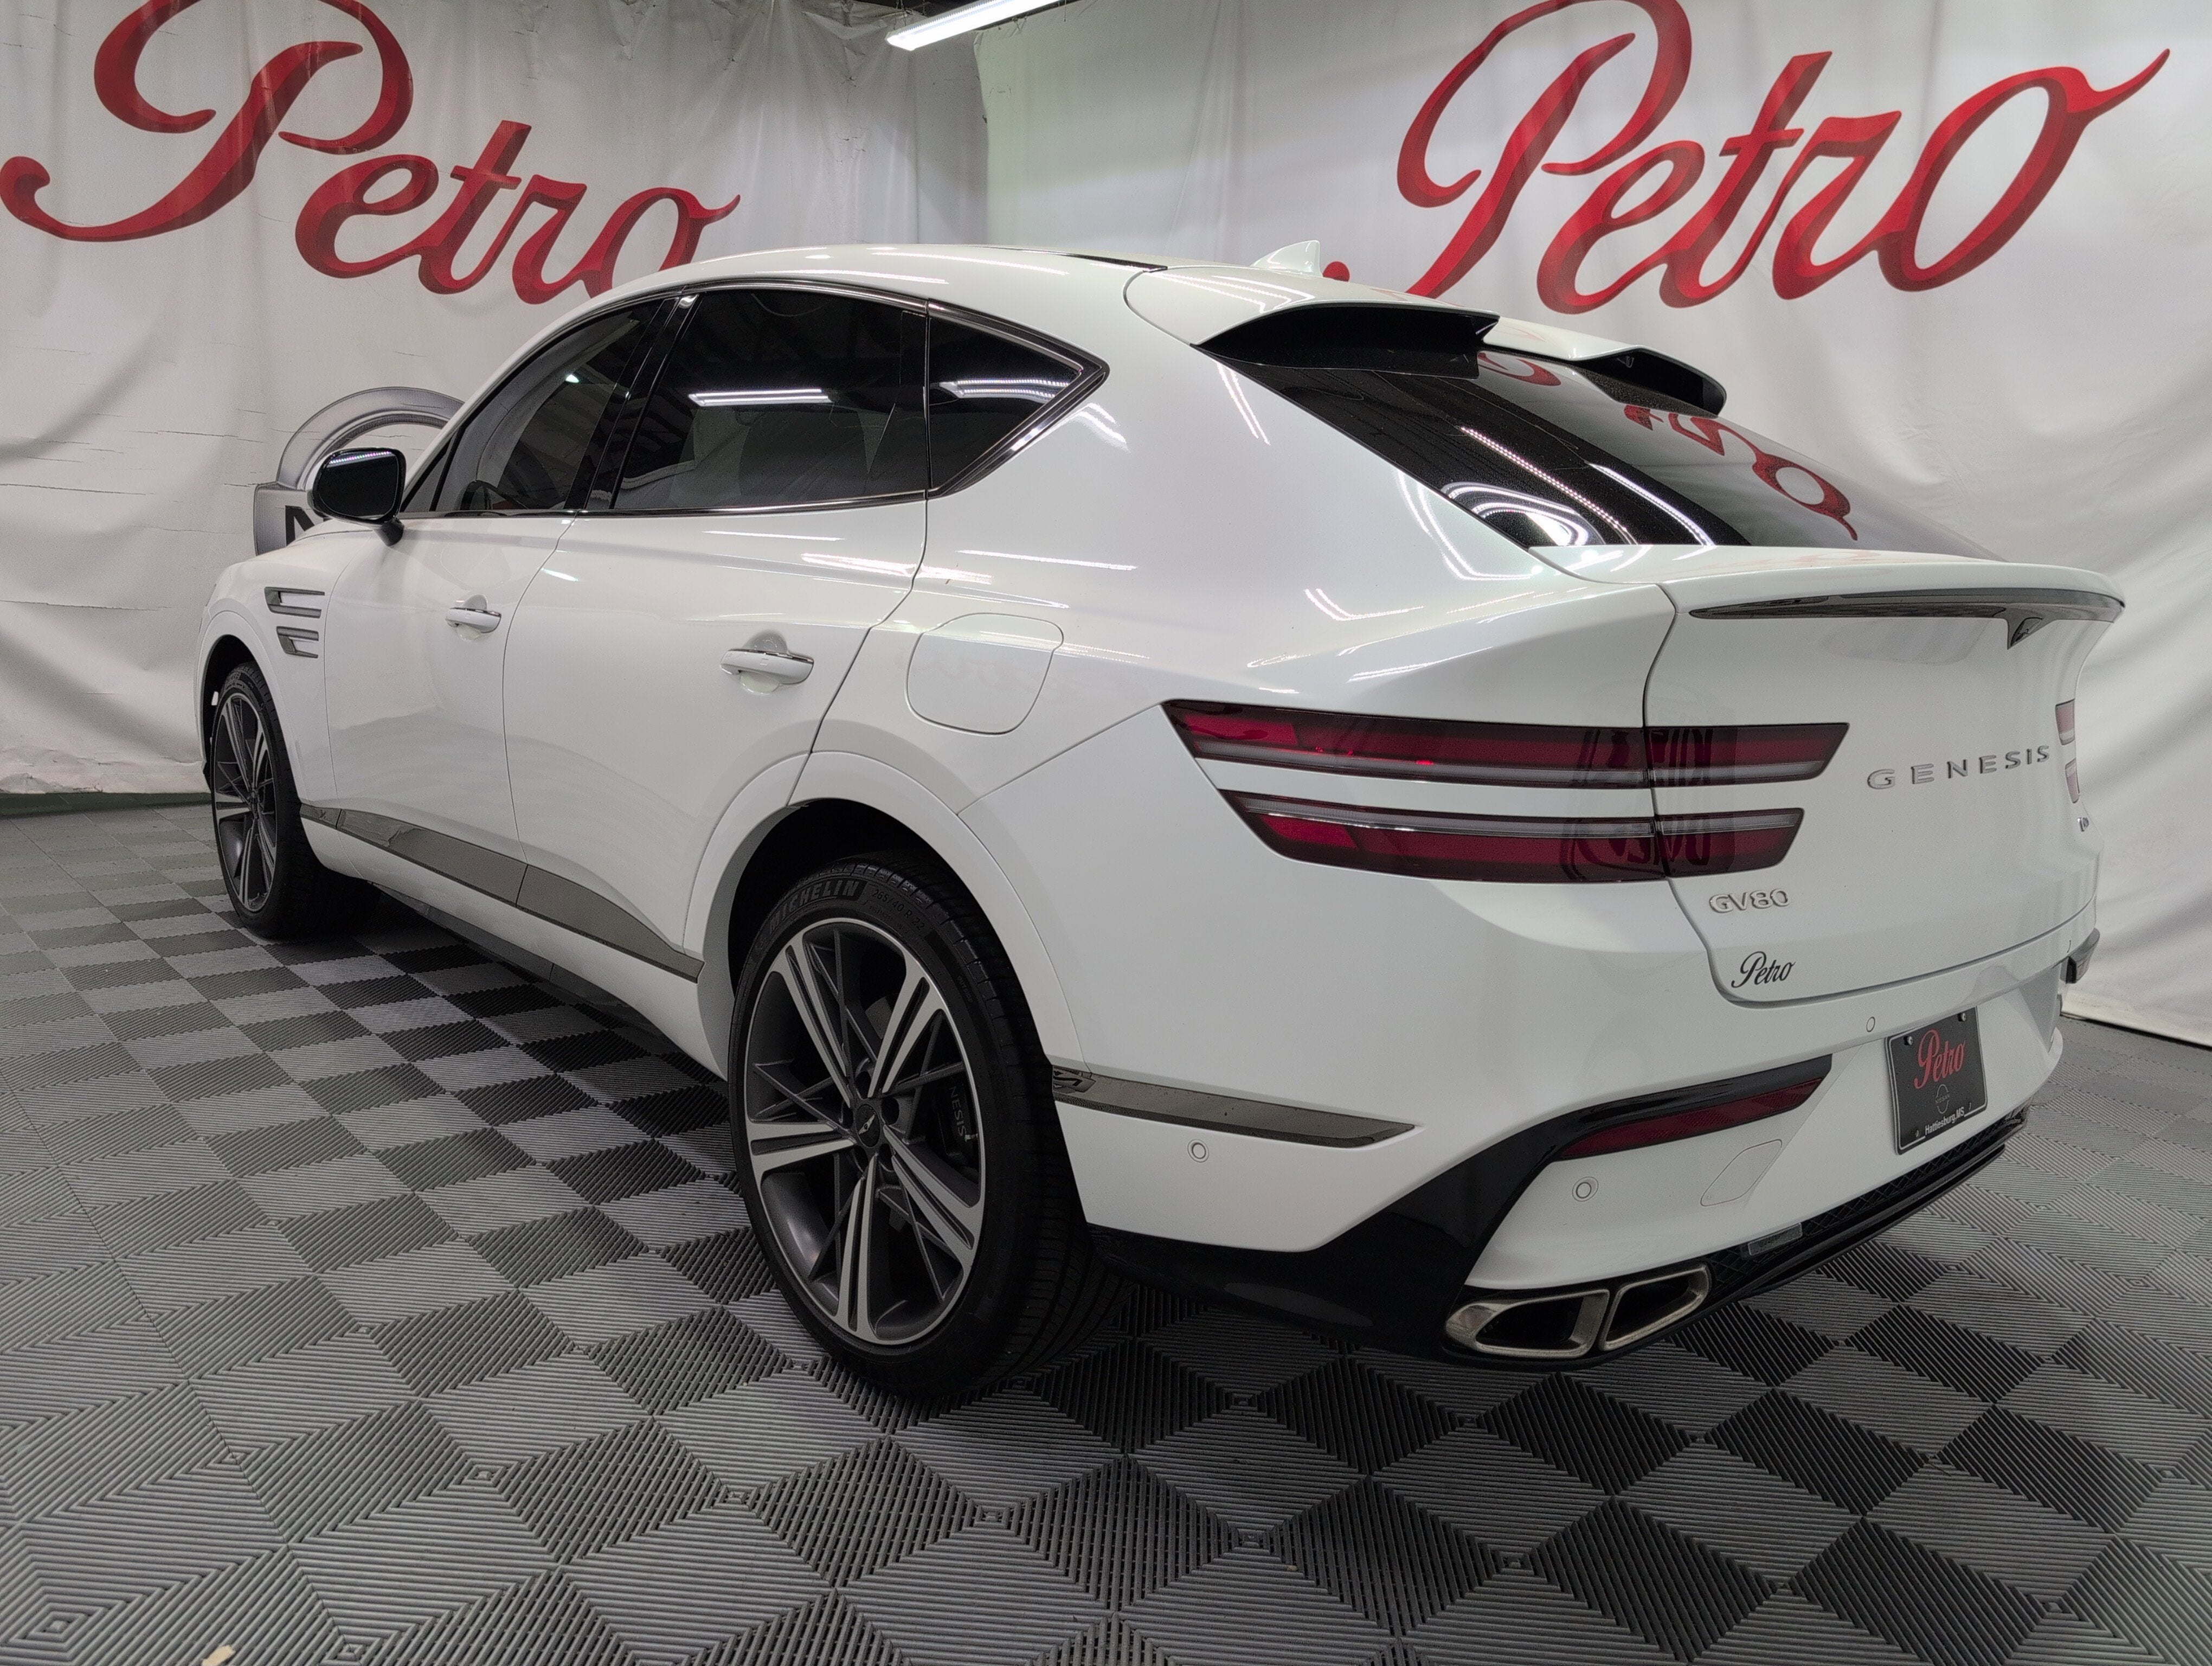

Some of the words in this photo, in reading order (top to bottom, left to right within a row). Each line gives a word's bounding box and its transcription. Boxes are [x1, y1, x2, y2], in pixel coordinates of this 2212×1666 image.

[0, 0, 741, 305] Petro
[1323, 0, 2170, 314] Petro
[1867, 745, 2050, 789] GENESIS
[768, 880, 860, 935] MICHELIN
[872, 889, 904, 912] 265/40
[904, 909, 913, 919] R
[912, 917, 926, 931] 22
[1708, 888, 1791, 914] GV80
[1731, 951, 1796, 989] Petro
[1913, 1029, 1966, 1090] Petro
[949, 1085, 967, 1137] NESIS
